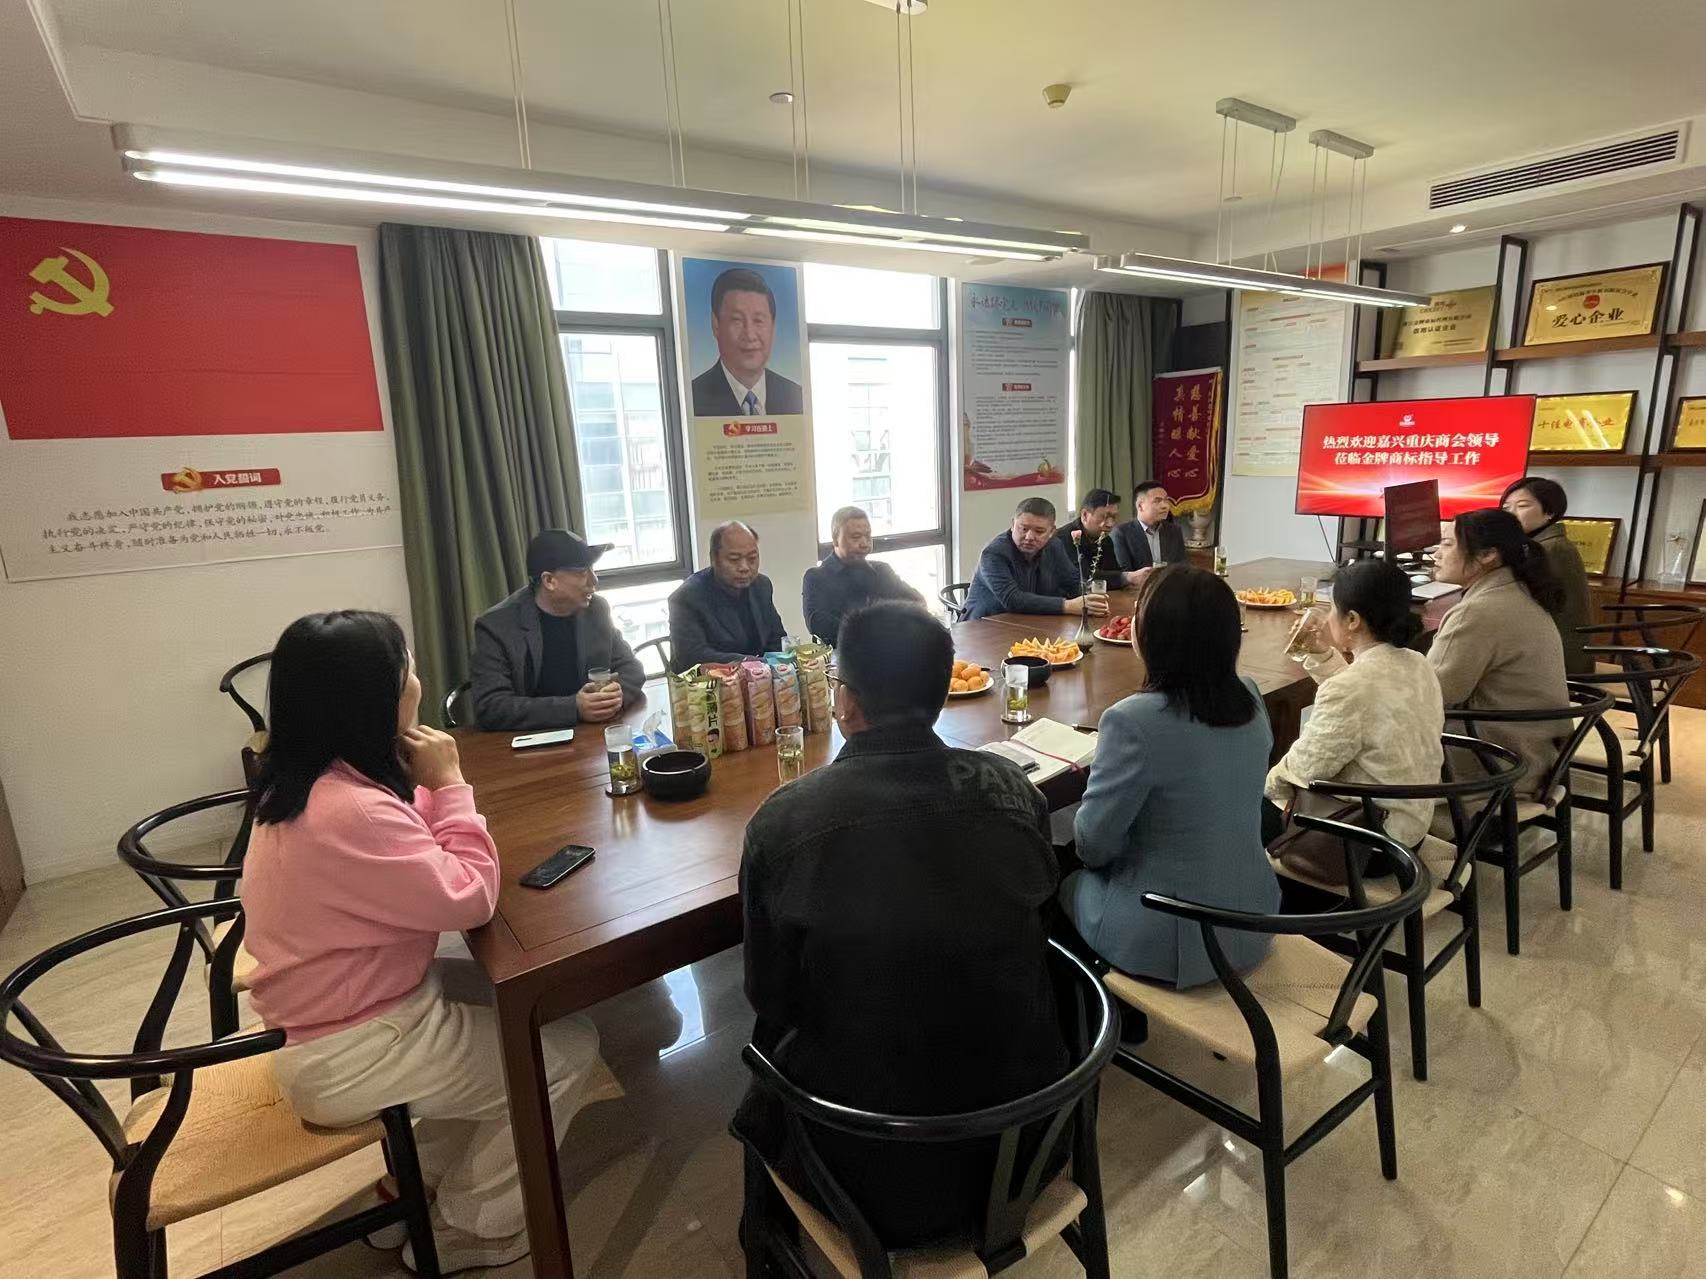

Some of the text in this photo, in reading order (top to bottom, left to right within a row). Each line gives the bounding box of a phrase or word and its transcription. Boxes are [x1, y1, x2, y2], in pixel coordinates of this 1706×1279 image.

[1551, 307, 1625, 328] 爱心企业
[1322, 432, 1500, 450] 热烈欢迎嘉兴重庆商会领导
[1334, 450, 1481, 466] 莅临金牌商标指导工作
[213, 472, 262, 485] 入党誓词
